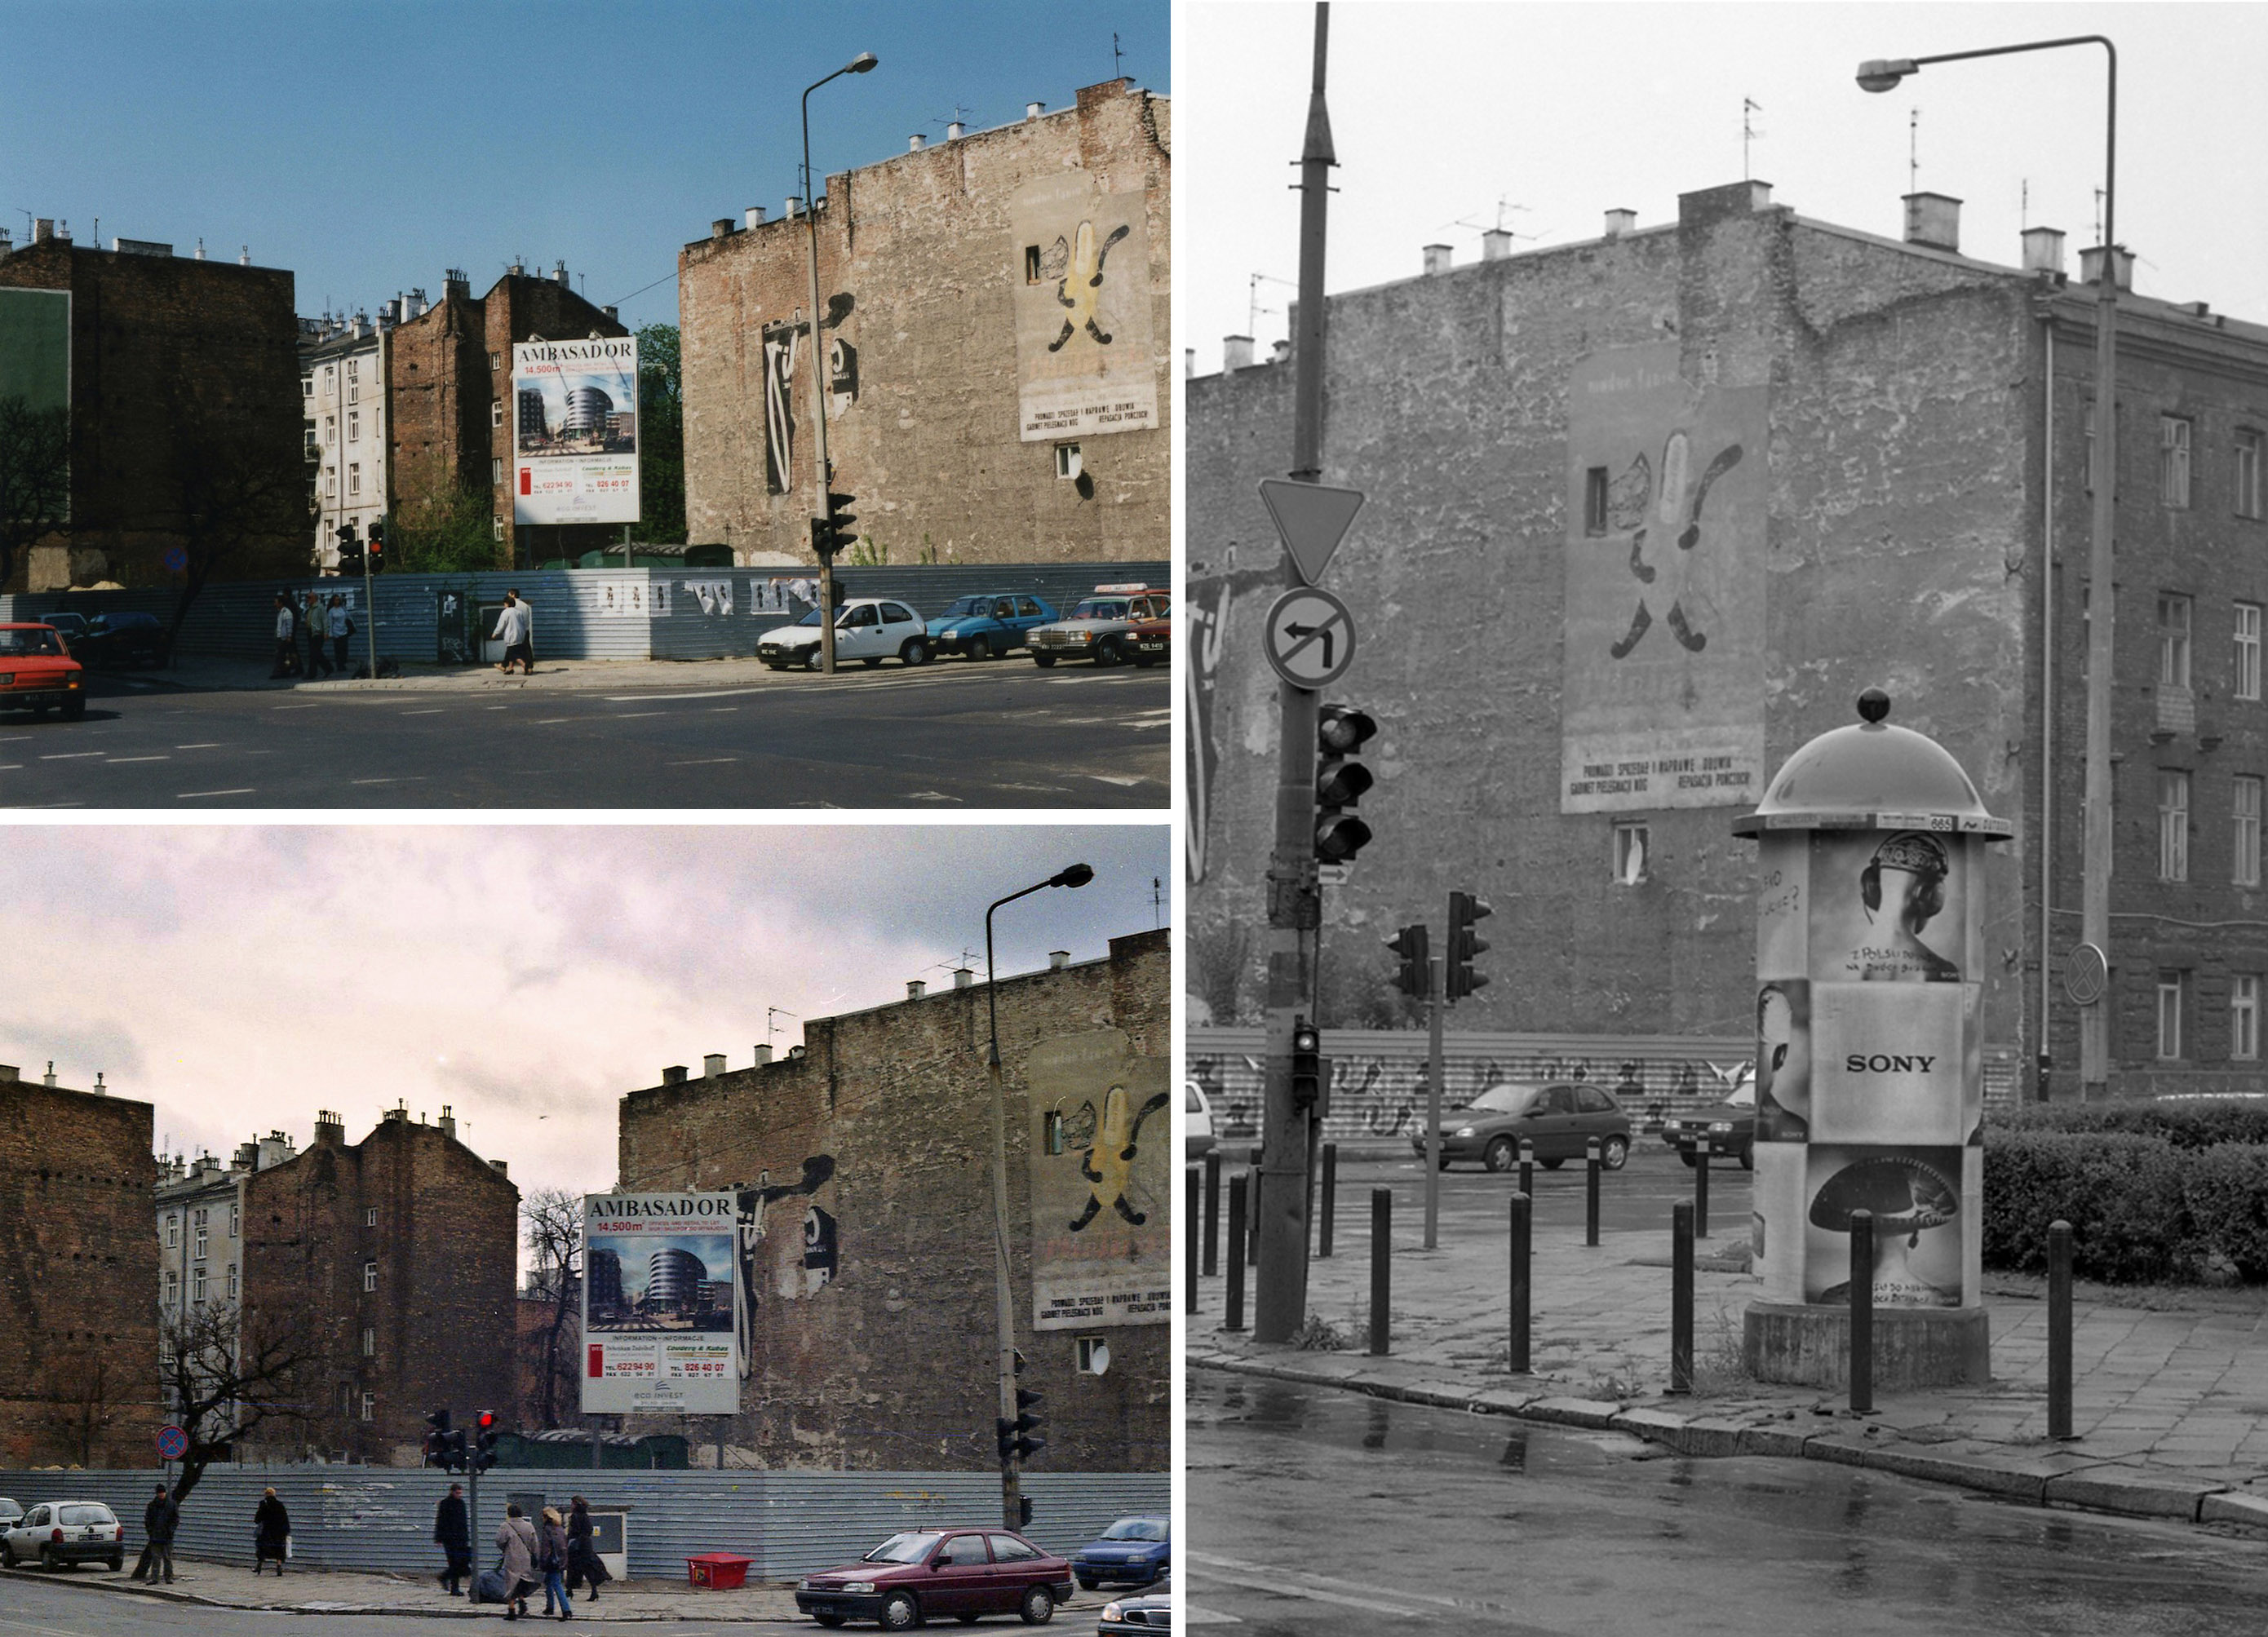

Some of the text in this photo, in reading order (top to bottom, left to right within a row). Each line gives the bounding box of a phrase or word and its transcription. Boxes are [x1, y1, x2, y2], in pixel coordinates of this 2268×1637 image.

[519, 343, 632, 363] AMBASADOR
[1846, 1055, 1936, 1073] SONY
[590, 1198, 731, 1218] AMBASADOR
[684, 1363, 699, 1371] 826
[702, 1363, 711, 1371] 40
[715, 1363, 724, 1371] 07
